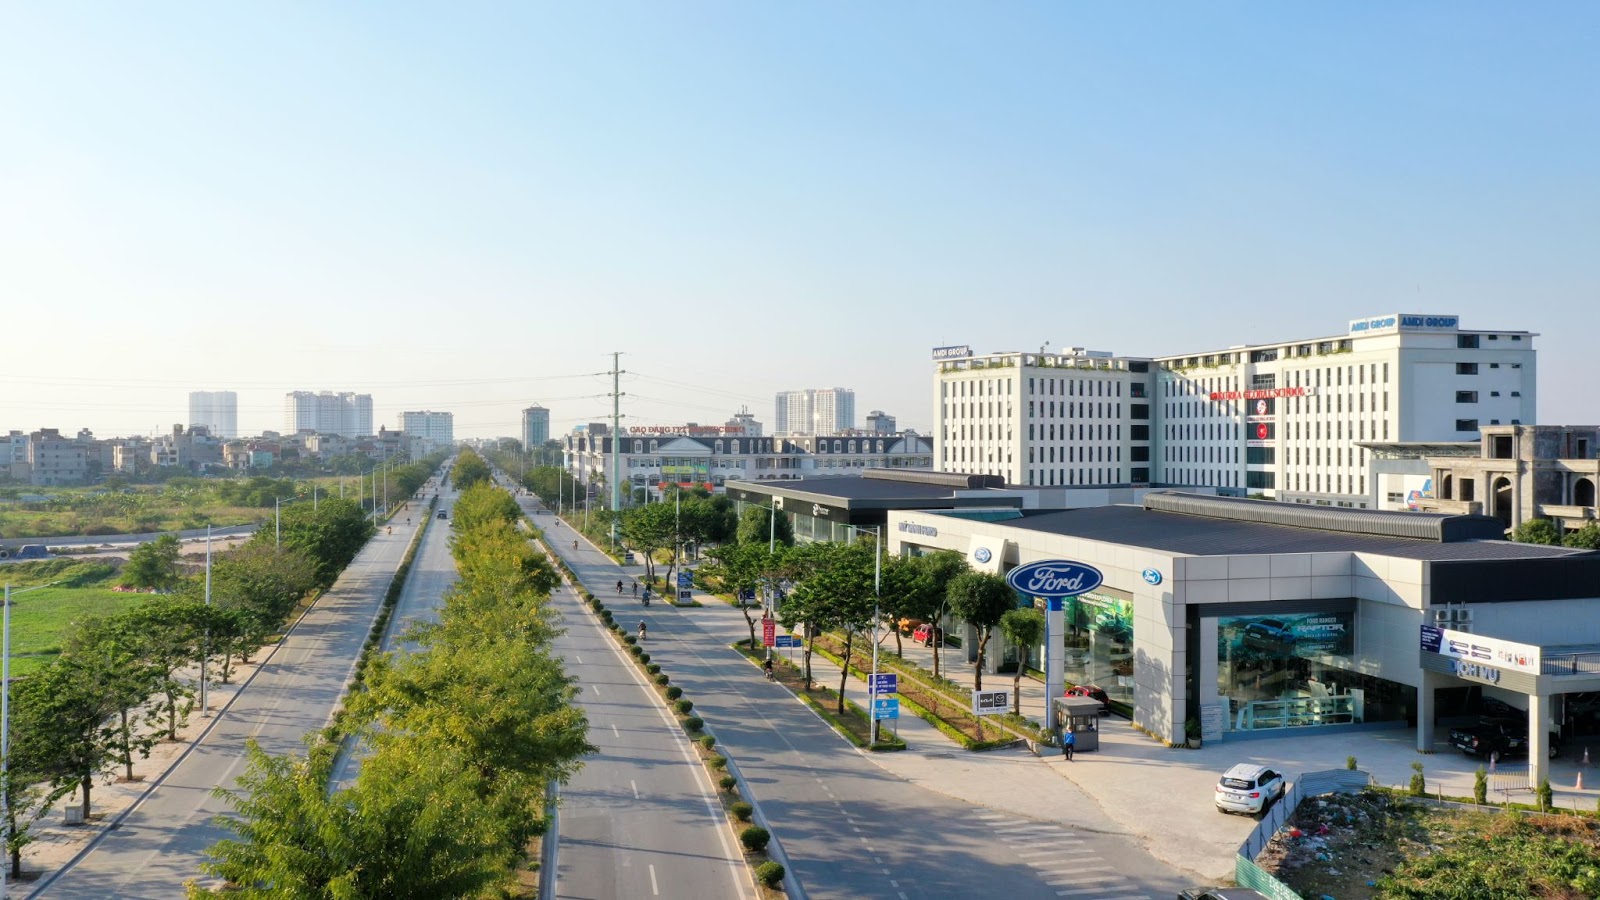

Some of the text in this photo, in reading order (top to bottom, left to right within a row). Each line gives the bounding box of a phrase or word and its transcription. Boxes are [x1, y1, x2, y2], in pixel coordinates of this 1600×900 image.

[1351, 318, 1396, 332] AMDI GROUP
[1401, 317, 1457, 327] AMDI GROUP
[933, 347, 969, 357] AMDI GROUP
[1217, 387, 1305, 400] KOREA GLOBAL SCHOOL
[1028, 567, 1084, 591] Ford
[1297, 623, 1345, 632] RAPTOR
